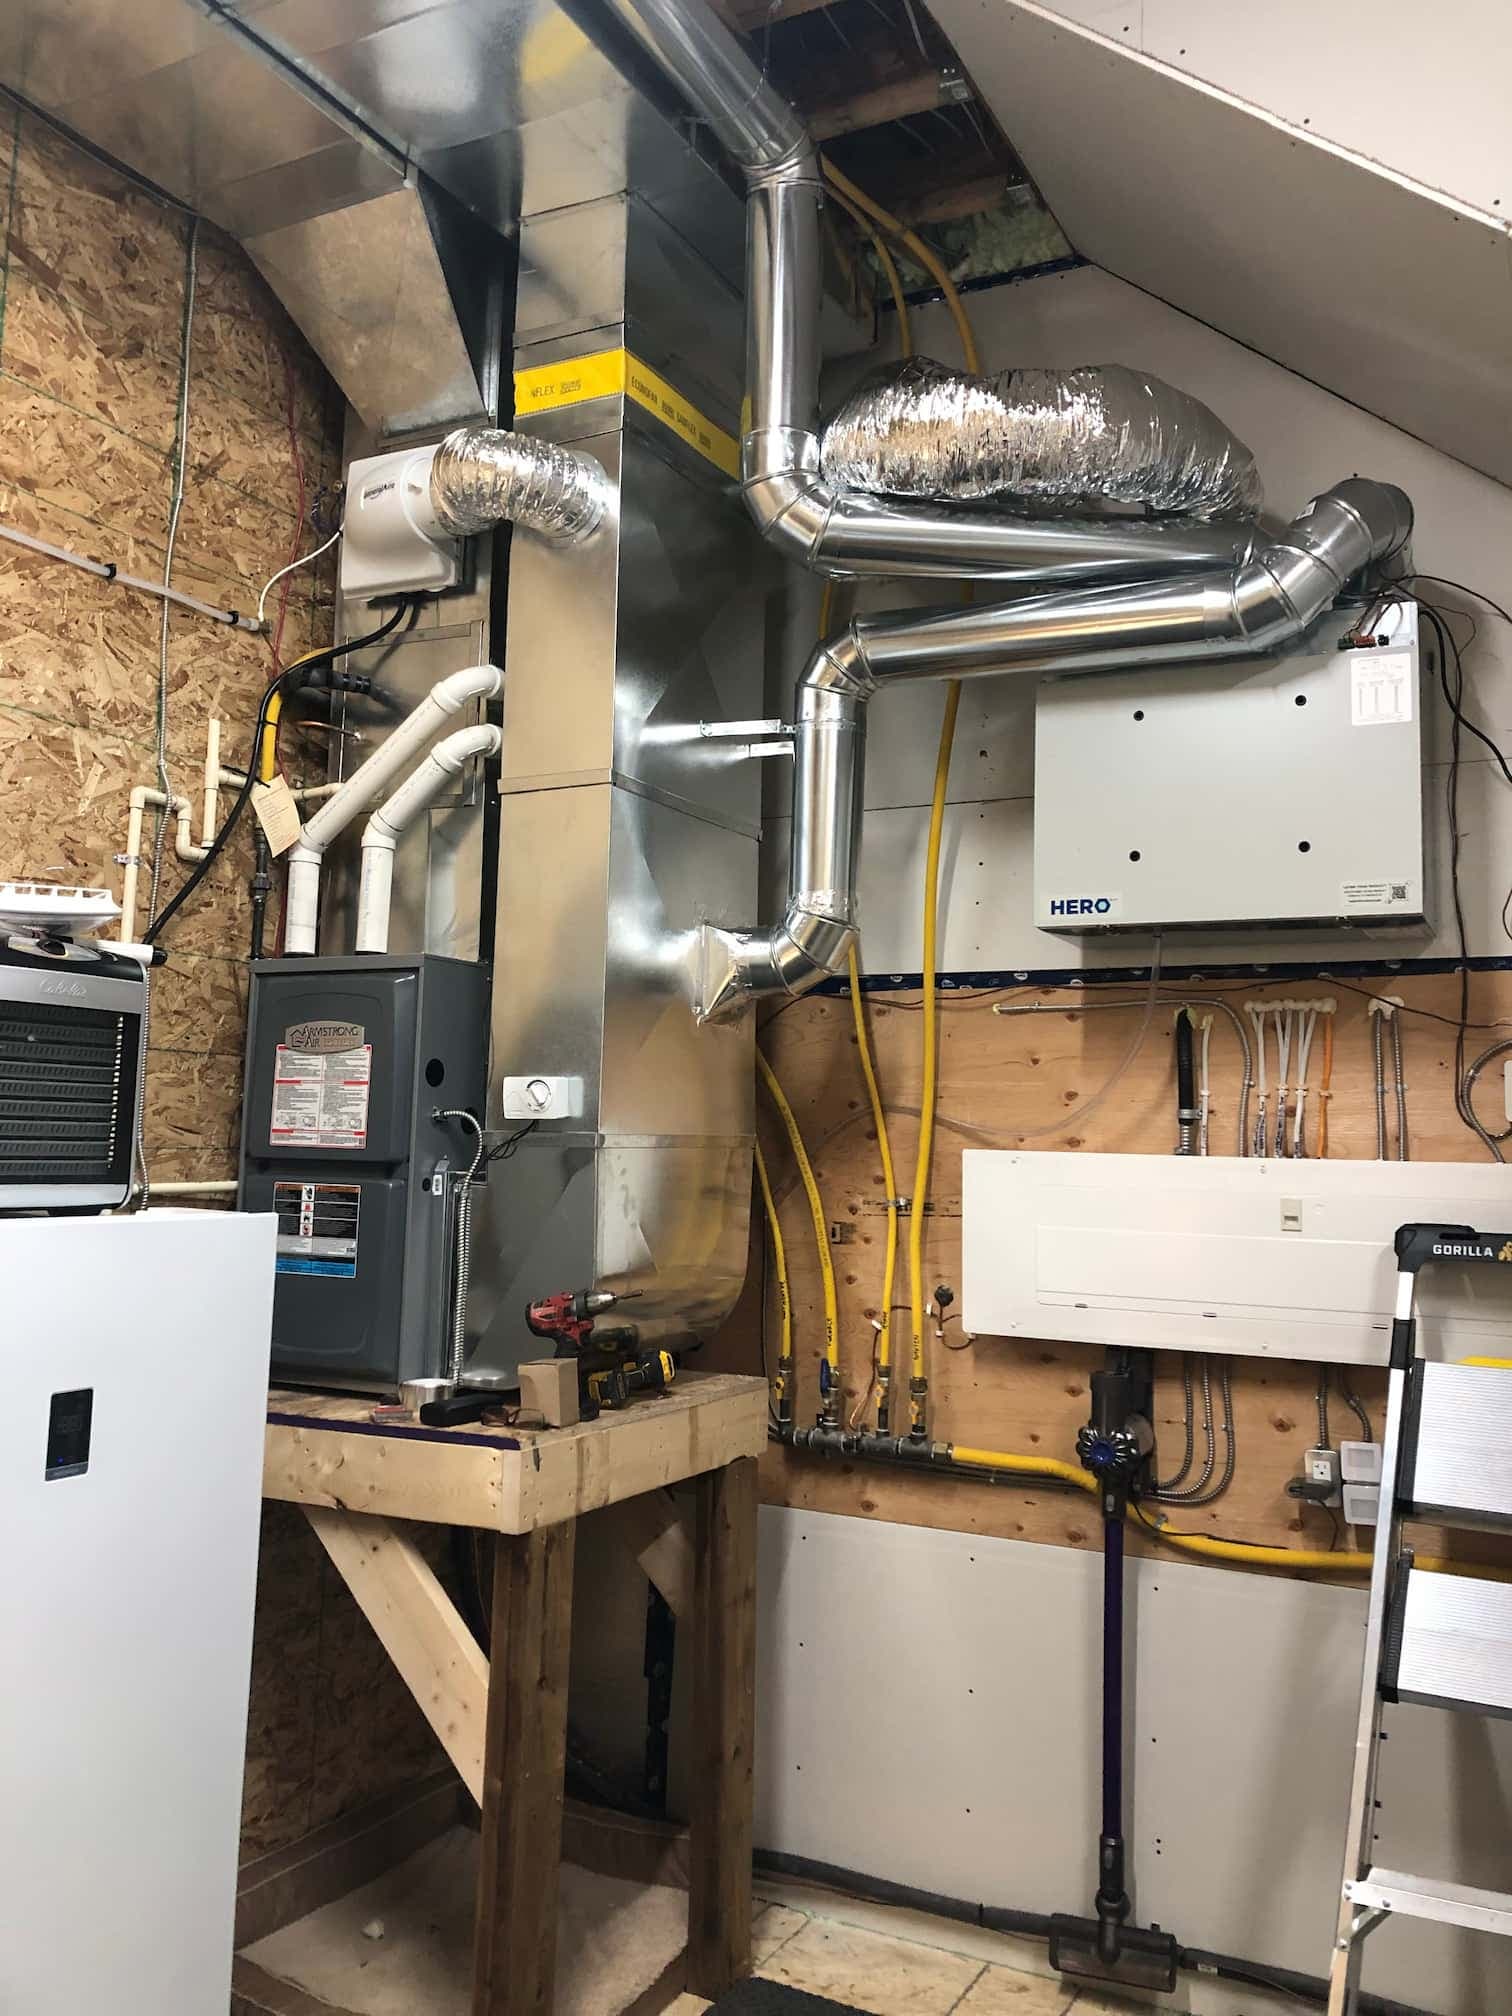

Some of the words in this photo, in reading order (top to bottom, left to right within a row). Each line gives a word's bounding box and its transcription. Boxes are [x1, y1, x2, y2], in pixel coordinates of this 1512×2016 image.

[1050, 898, 1111, 915] HERO
[302, 1025, 359, 1037] ARMSTRONG
[1432, 1244, 1494, 1257] GORILLA
